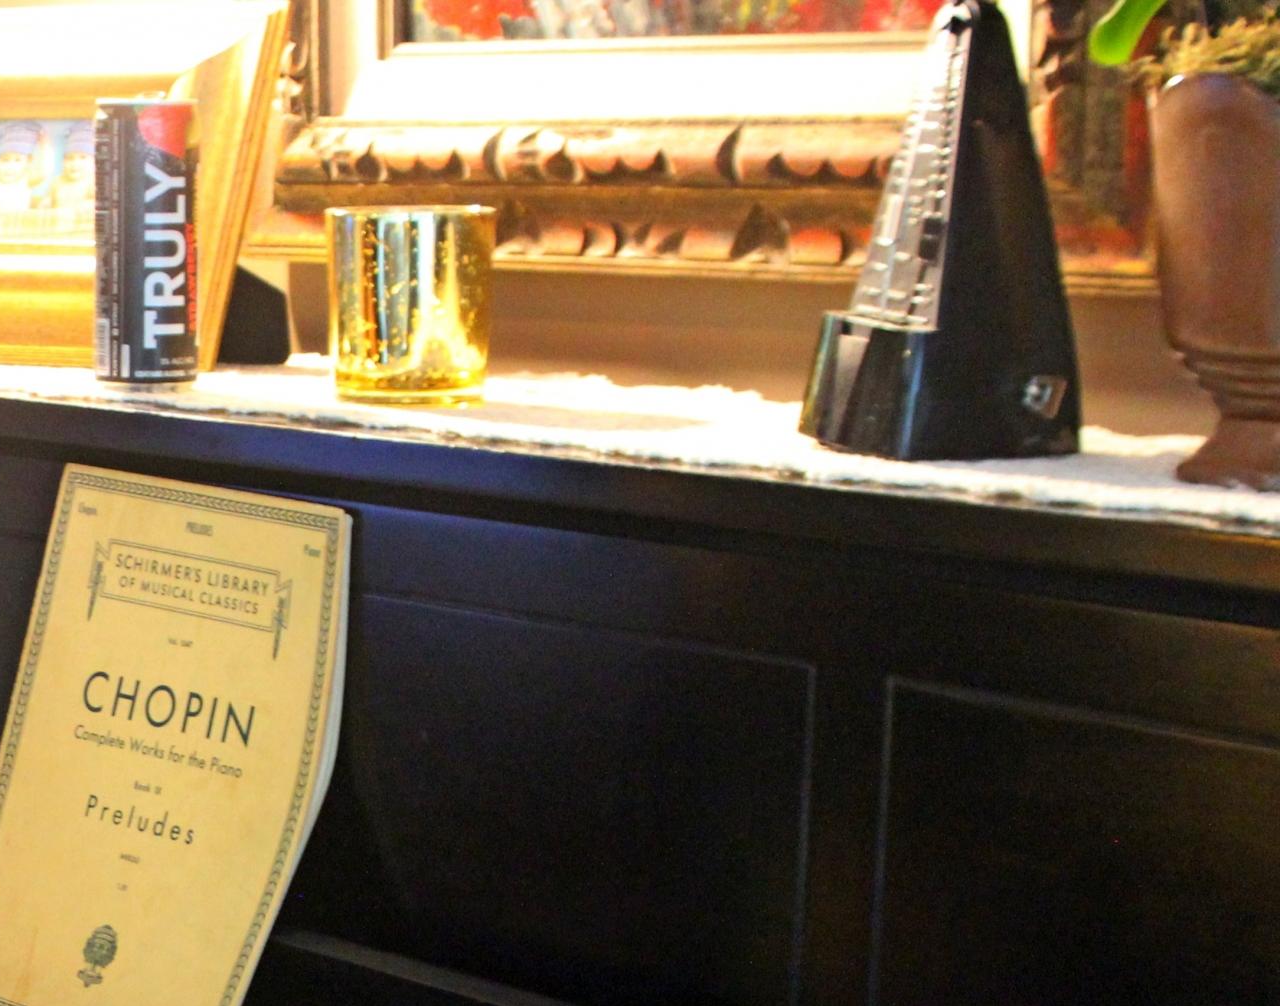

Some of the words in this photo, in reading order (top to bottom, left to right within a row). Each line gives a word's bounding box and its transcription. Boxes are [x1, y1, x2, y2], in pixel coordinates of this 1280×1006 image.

[143, 162, 186, 349] TRULY
[115, 553, 202, 583] SCHIRMER'S
[207, 571, 269, 596] LIBRARY
[119, 575, 136, 588] OF
[140, 580, 195, 602] MUSICAL
[199, 591, 259, 615] CLASSICS
[83, 671, 256, 748] CHOPIN
[74, 724, 125, 750] Complete
[130, 736, 165, 760] Works
[168, 745, 185, 763] for
[188, 752, 206, 770] the
[210, 756, 243, 778] Piano
[84, 794, 195, 845] Preludes
